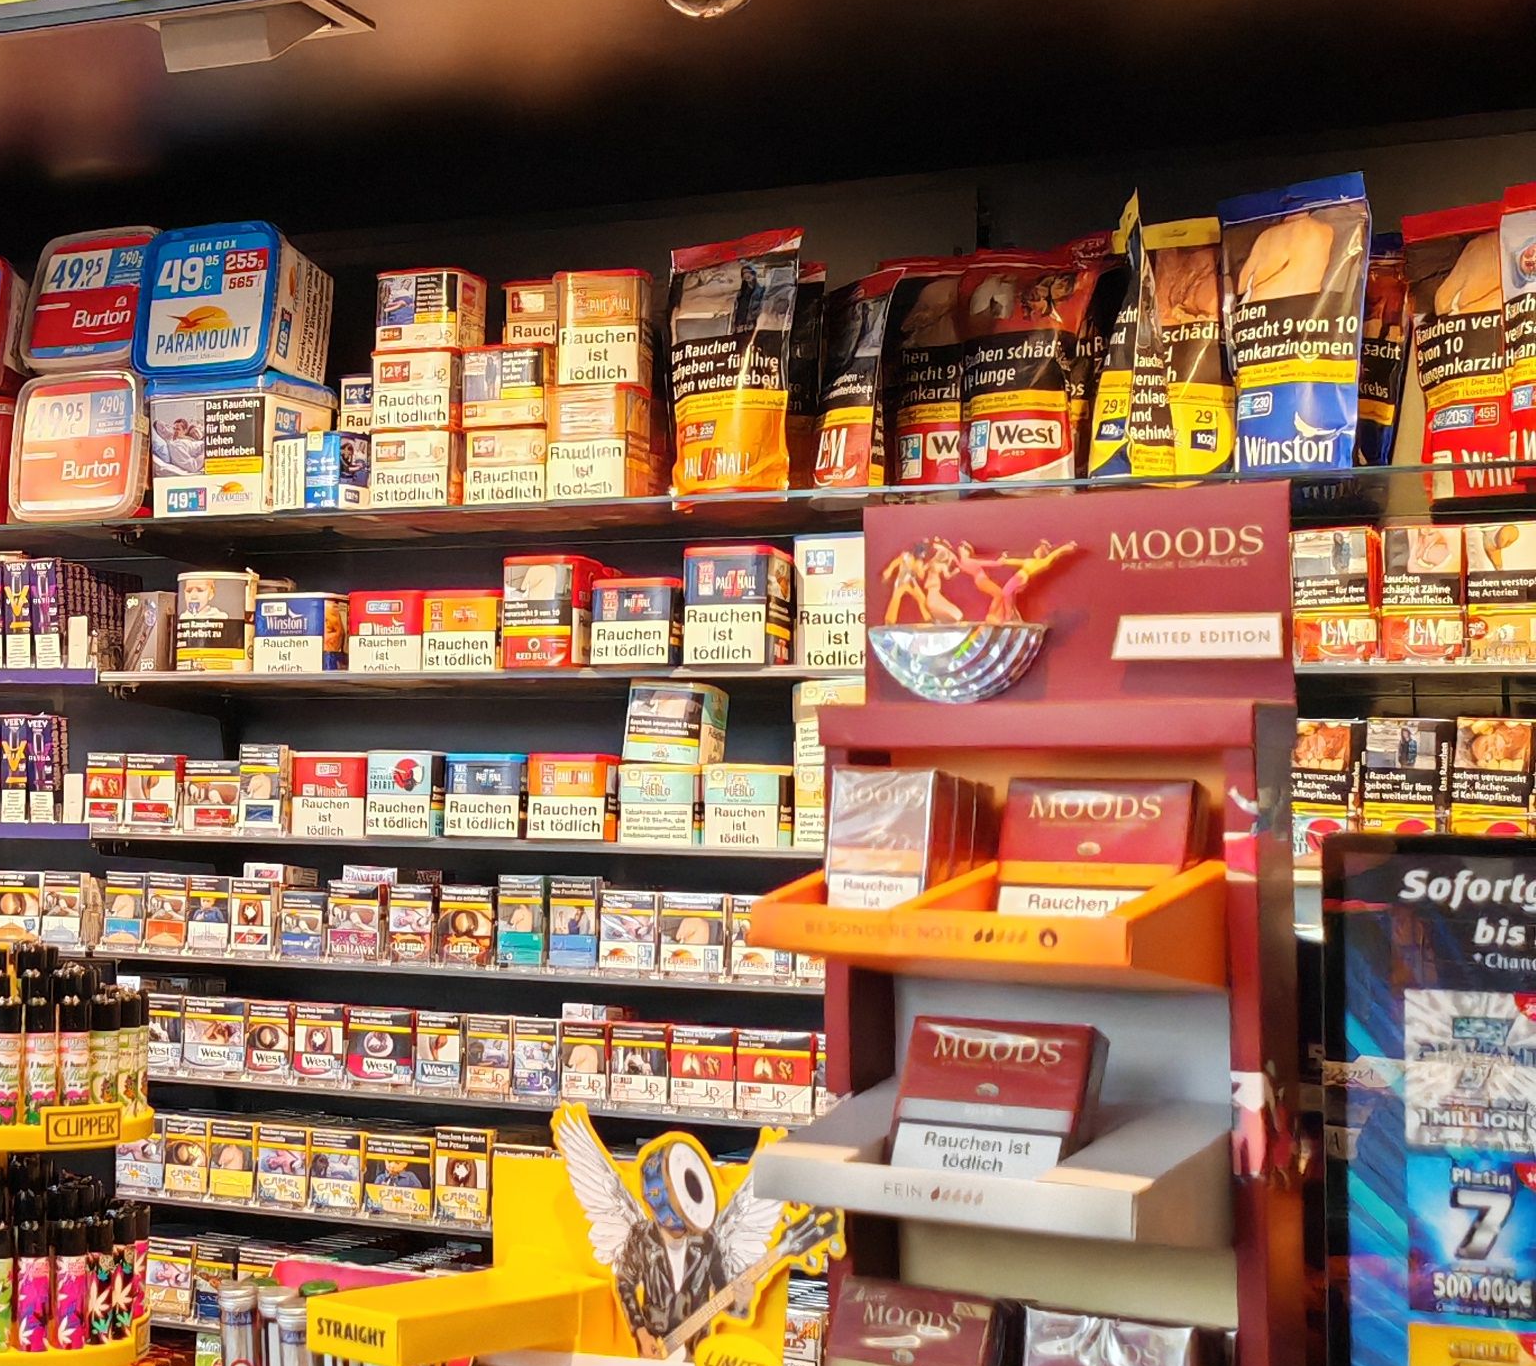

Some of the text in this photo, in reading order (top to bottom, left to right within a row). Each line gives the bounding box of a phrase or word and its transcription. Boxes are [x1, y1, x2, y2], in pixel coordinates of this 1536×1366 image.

[72, 308, 131, 331] Burton
[1296, 317, 1329, 333] von
[1335, 315, 1358, 333] 10
[155, 327, 250, 354] PARAMOUNT
[560, 327, 637, 345] Rauchen
[588, 346, 609, 362] ist
[568, 363, 628, 382] tödlich
[994, 423, 1056, 445] West
[1243, 435, 1334, 468] Winston
[60, 460, 121, 482] Burton
[1108, 524, 1266, 563] MOODS
[686, 609, 763, 623] Rauchen
[713, 627, 733, 642] ist
[1126, 628, 1273, 646] LIMITED EDITION
[693, 644, 752, 661] tödlich
[1028, 794, 1163, 822] MOODS
[1027, 892, 1109, 914] Rauchen
[1473, 916, 1527, 947] bis
[933, 1034, 1063, 1066] MOODS
[53, 1116, 116, 1138] CLIPPER
[1430, 1107, 1525, 1132] MILLION
[923, 1130, 1032, 1156] Rauchen ist
[941, 1152, 1004, 1173] tödlich
[1454, 1188, 1515, 1262] 7
[316, 1317, 387, 1349] STRAIGHT
